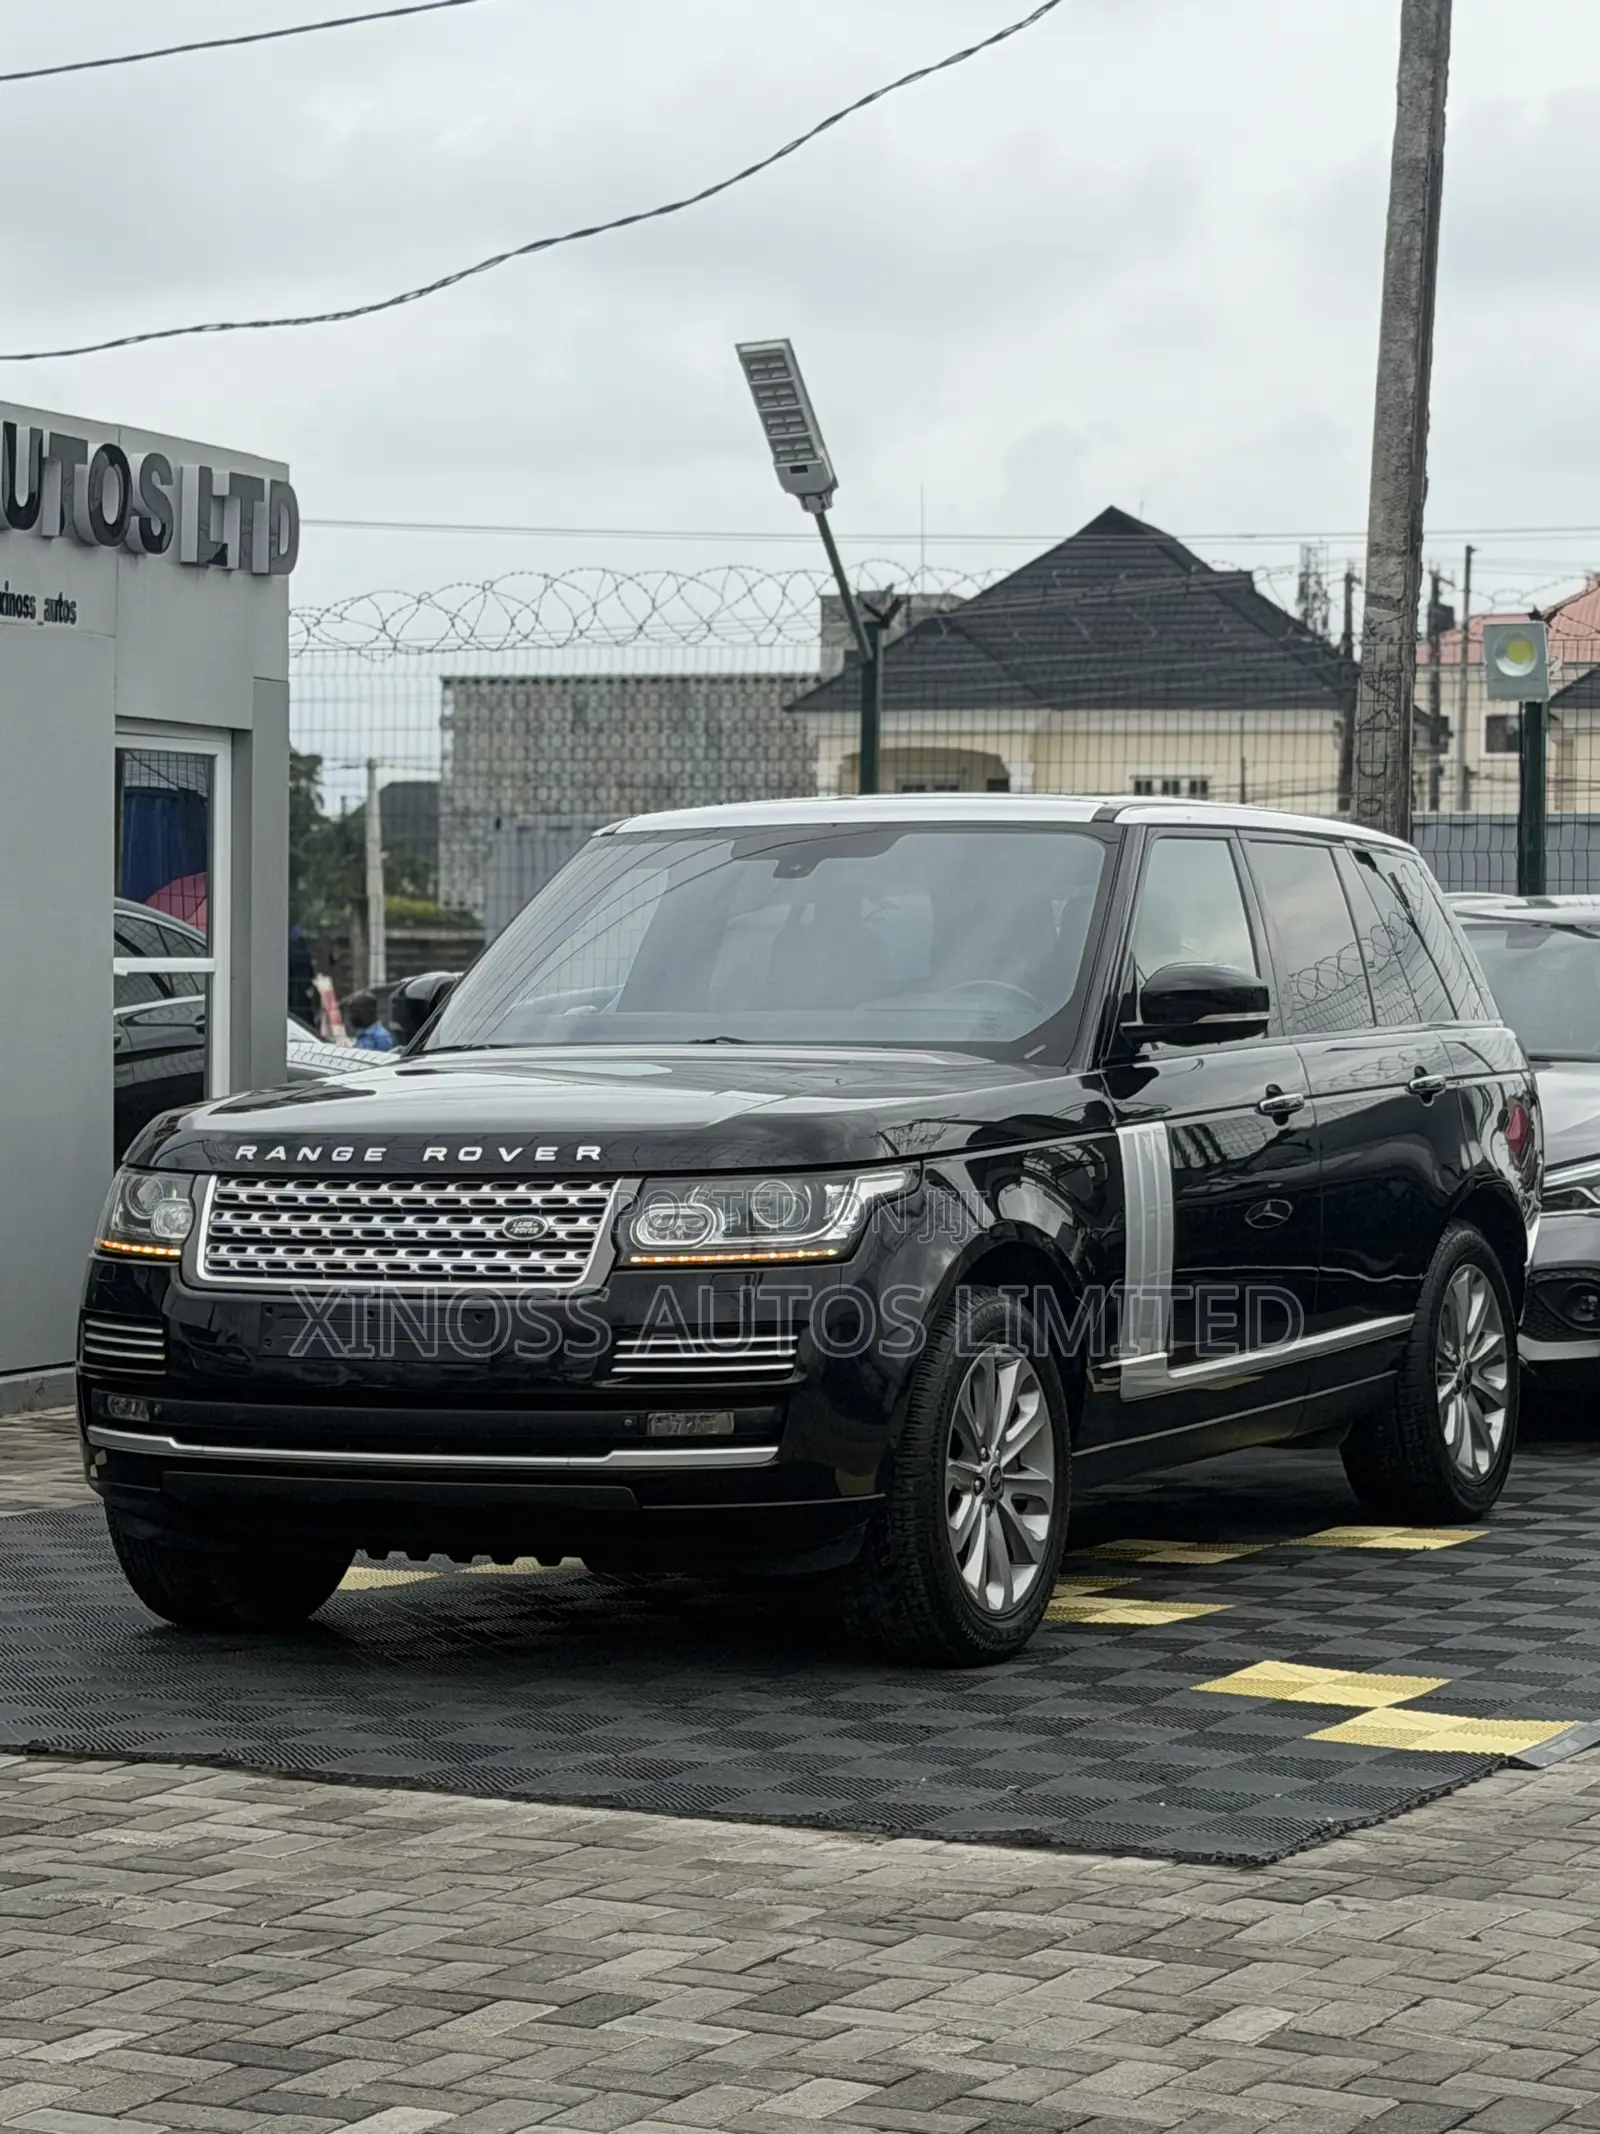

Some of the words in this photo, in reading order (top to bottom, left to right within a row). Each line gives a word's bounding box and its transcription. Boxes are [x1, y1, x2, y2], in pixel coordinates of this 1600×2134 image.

[180, 464, 300, 575] LTD
[235, 1145, 387, 1162] RANGE
[422, 1145, 602, 1162] ROVER
